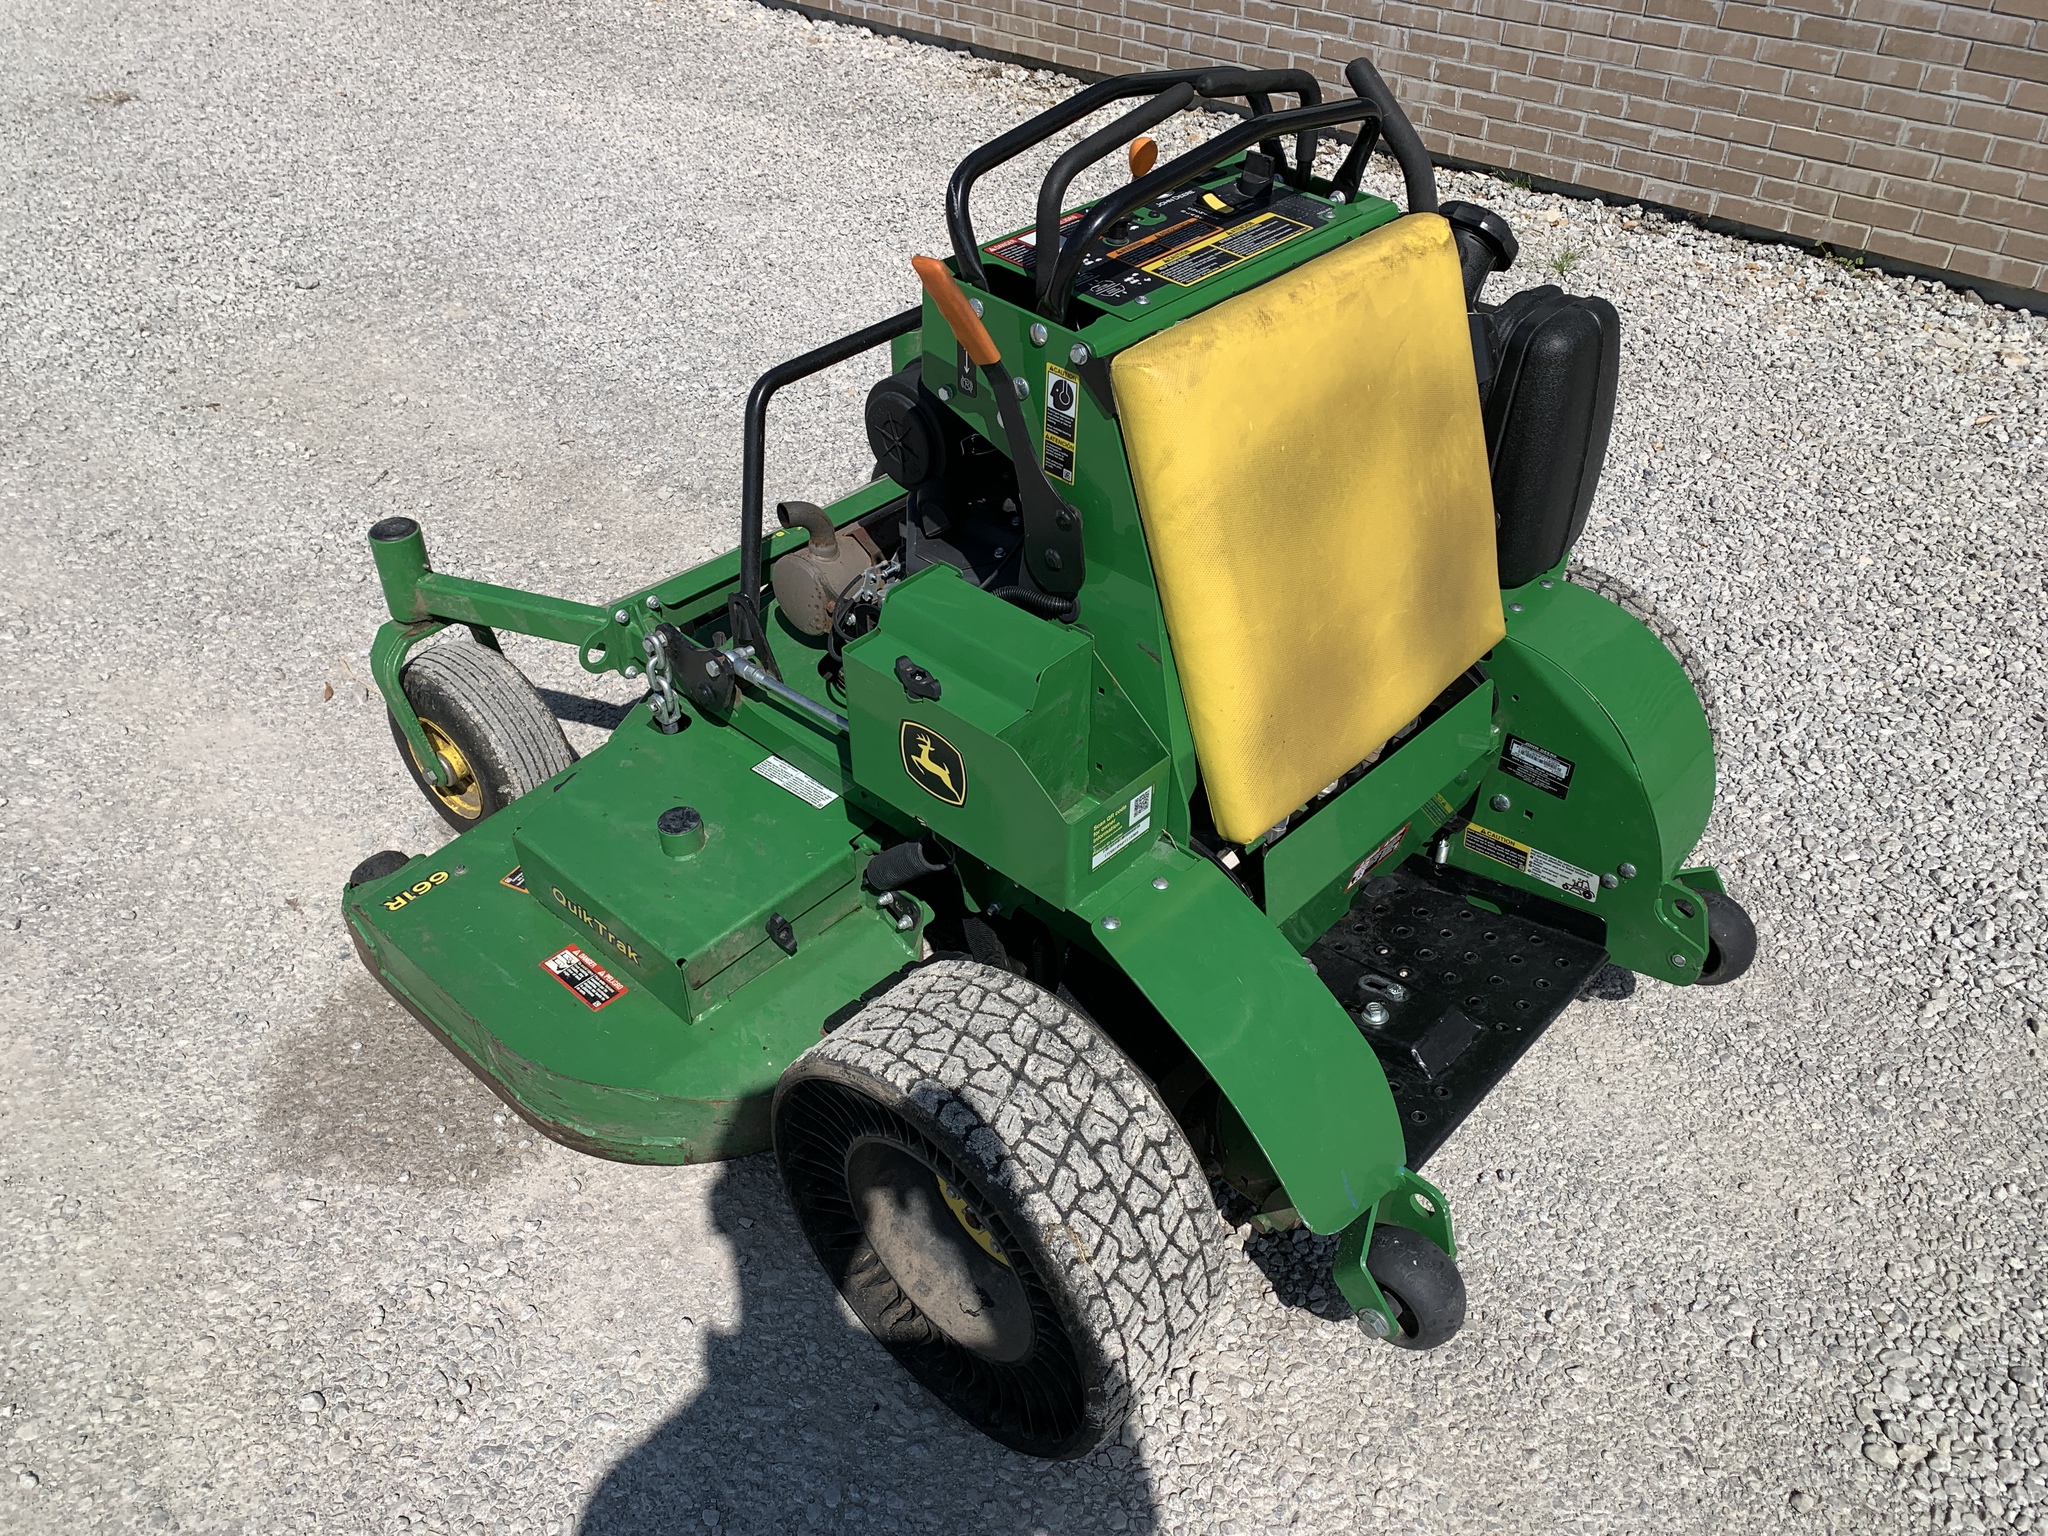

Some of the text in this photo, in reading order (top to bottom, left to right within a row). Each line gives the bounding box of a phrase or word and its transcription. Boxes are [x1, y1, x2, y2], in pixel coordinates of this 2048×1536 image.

[1053, 366, 1077, 381] CAUTION
[1486, 830, 1517, 848] CAUTION
[381, 870, 450, 912] 661R
[551, 886, 640, 965] QuikTrak
[578, 953, 598, 969] DANGER
[603, 975, 624, 991] PELIGRO
